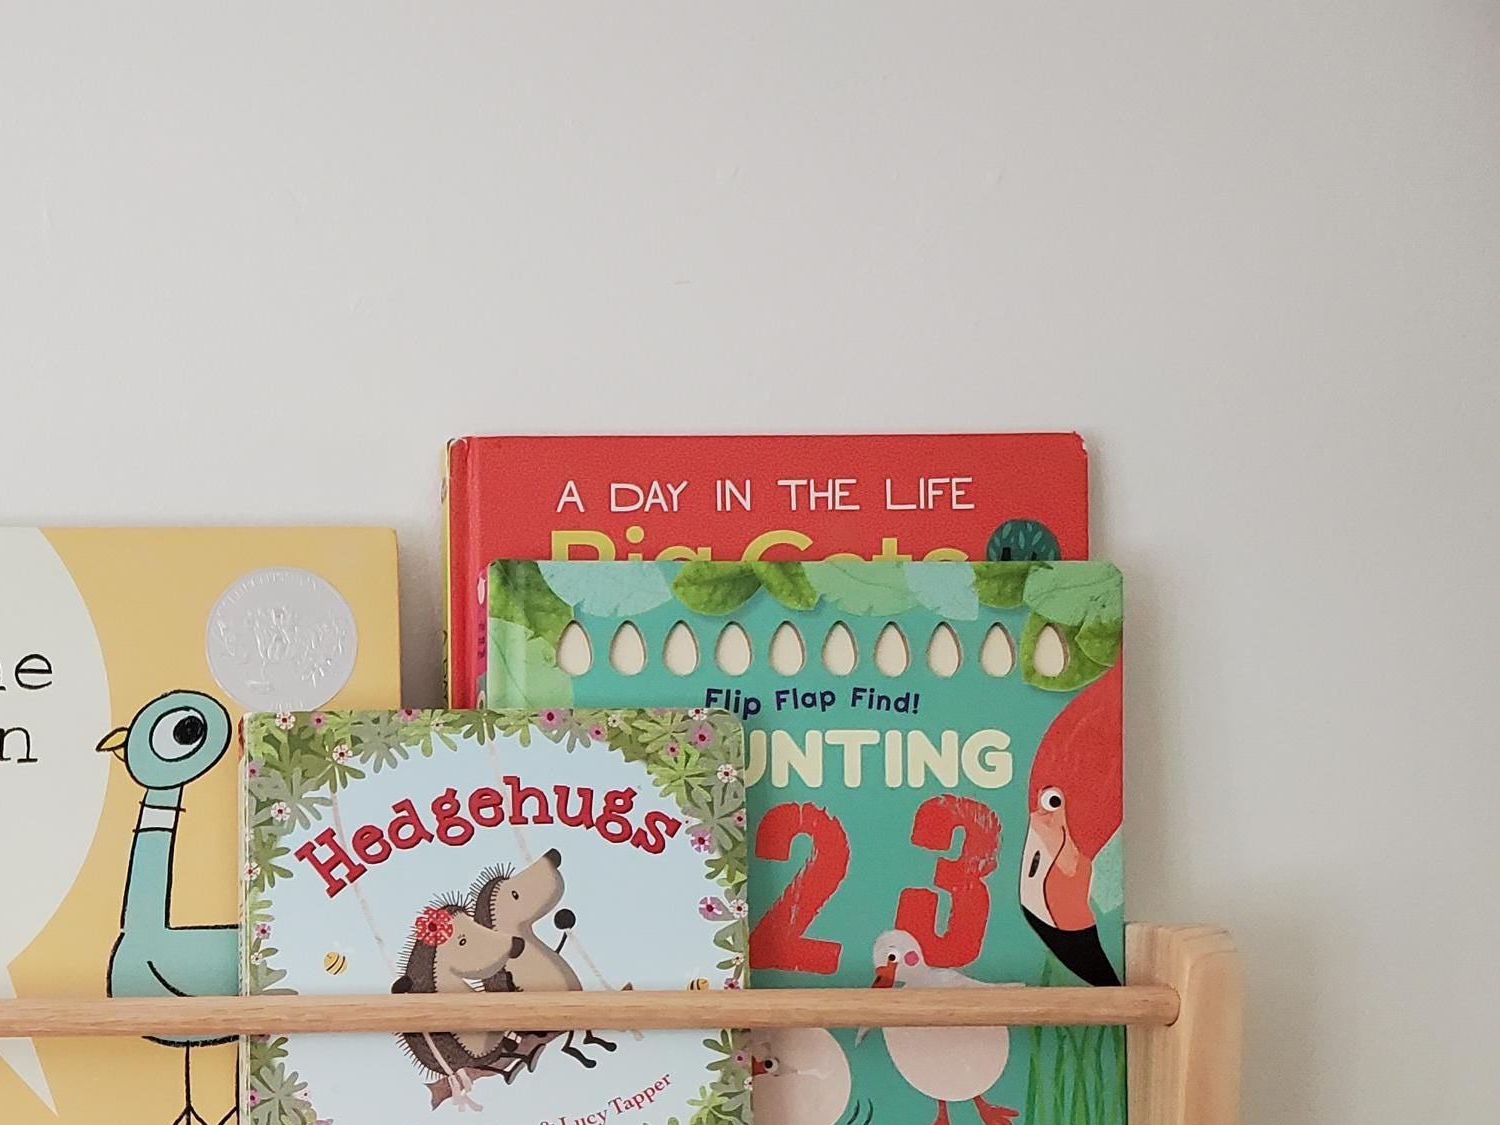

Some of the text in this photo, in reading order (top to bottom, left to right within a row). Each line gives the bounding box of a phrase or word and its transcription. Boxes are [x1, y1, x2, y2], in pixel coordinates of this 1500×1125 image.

[557, 478, 974, 512] A DAY IN THE LIFE
[705, 687, 920, 720] Flip Flap Find!
[295, 776, 681, 897] Hedgehugs
[749, 794, 1002, 974] 2 3
[611, 1073, 671, 1116] Tapper
